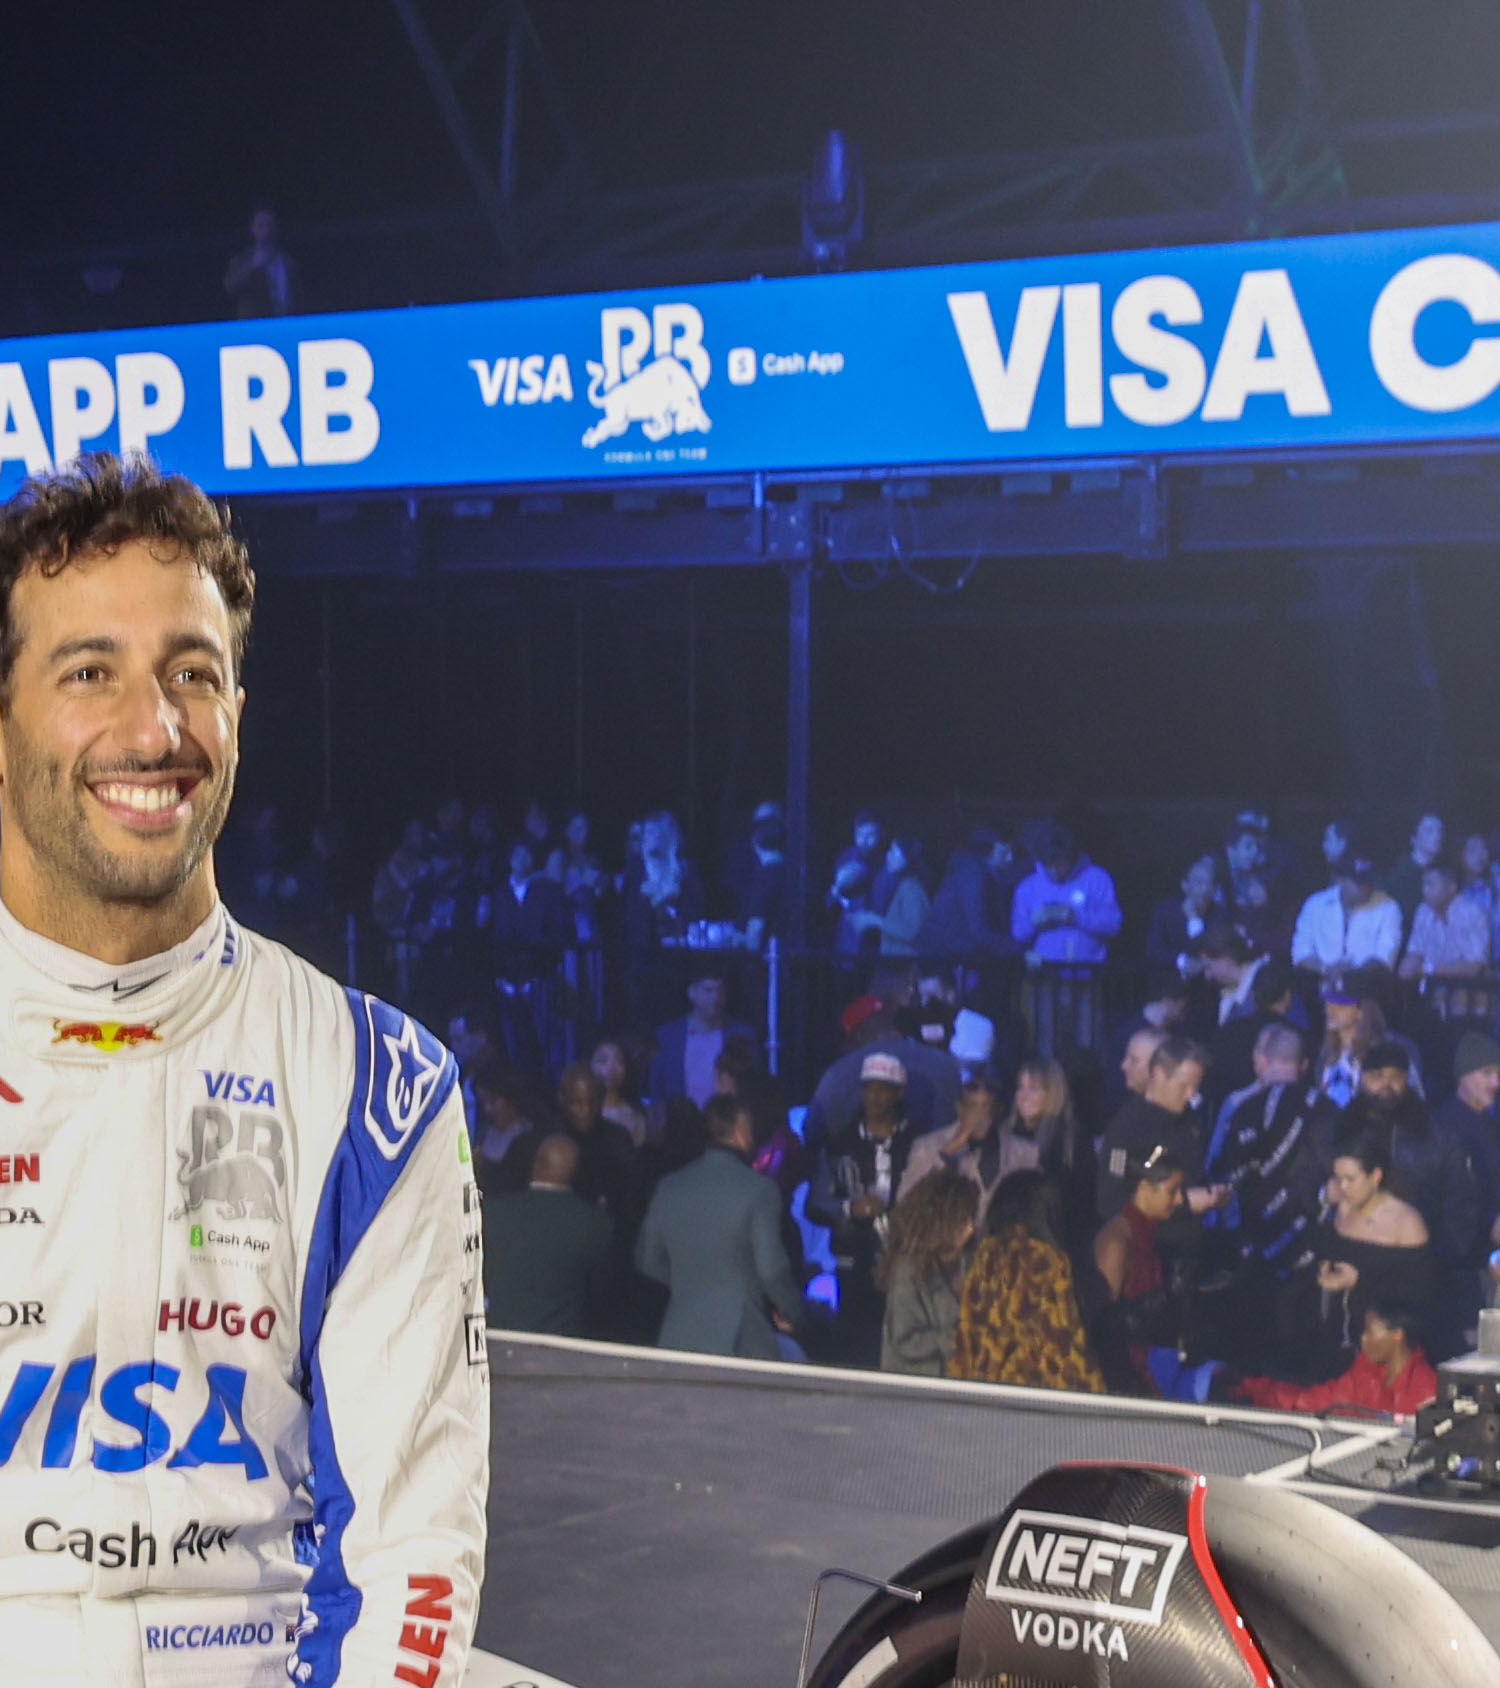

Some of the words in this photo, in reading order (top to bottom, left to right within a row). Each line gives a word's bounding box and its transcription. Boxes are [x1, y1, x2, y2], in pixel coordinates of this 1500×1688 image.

[947, 269, 1332, 432] VISA
[219, 338, 381, 471] RB
[468, 354, 574, 407] VISA
[762, 353, 804, 377] Cash
[808, 350, 845, 374] App
[198, 1070, 276, 1107] VISA
[207, 1230, 239, 1246] Cash
[243, 1235, 271, 1252] App
[157, 1297, 277, 1341] HUGO
[23, 1516, 157, 1569] Cash
[1009, 1529, 1158, 1599] NEFT
[145, 1620, 275, 1652] RICCIARDO
[1011, 1608, 1129, 1662] VODKA
